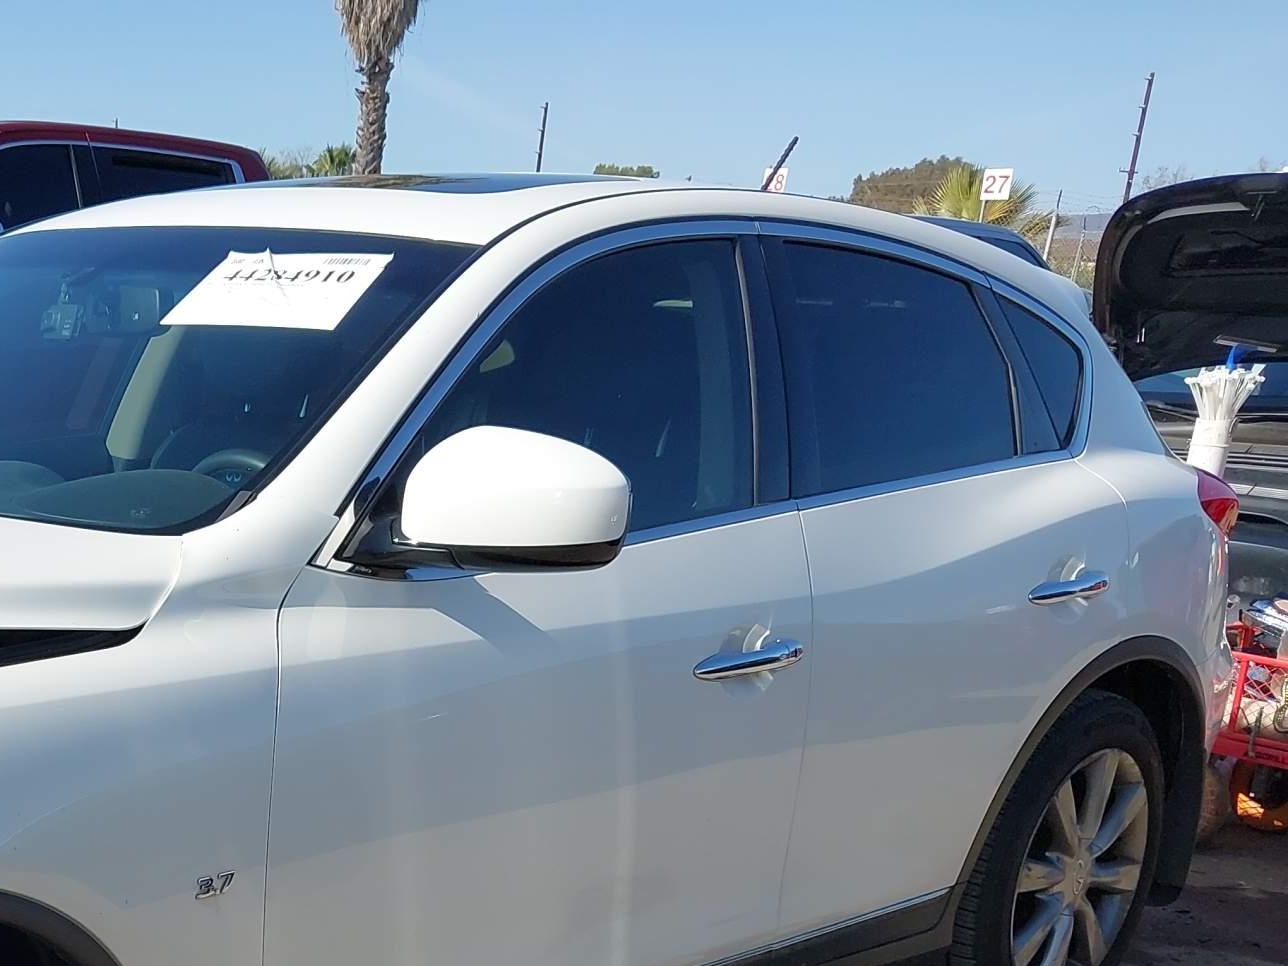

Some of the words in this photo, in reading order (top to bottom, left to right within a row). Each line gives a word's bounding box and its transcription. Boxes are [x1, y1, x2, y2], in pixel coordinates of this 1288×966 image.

[983, 175, 1011, 194] 27
[224, 269, 356, 283] 44284910
[195, 869, 236, 900] 3.7
